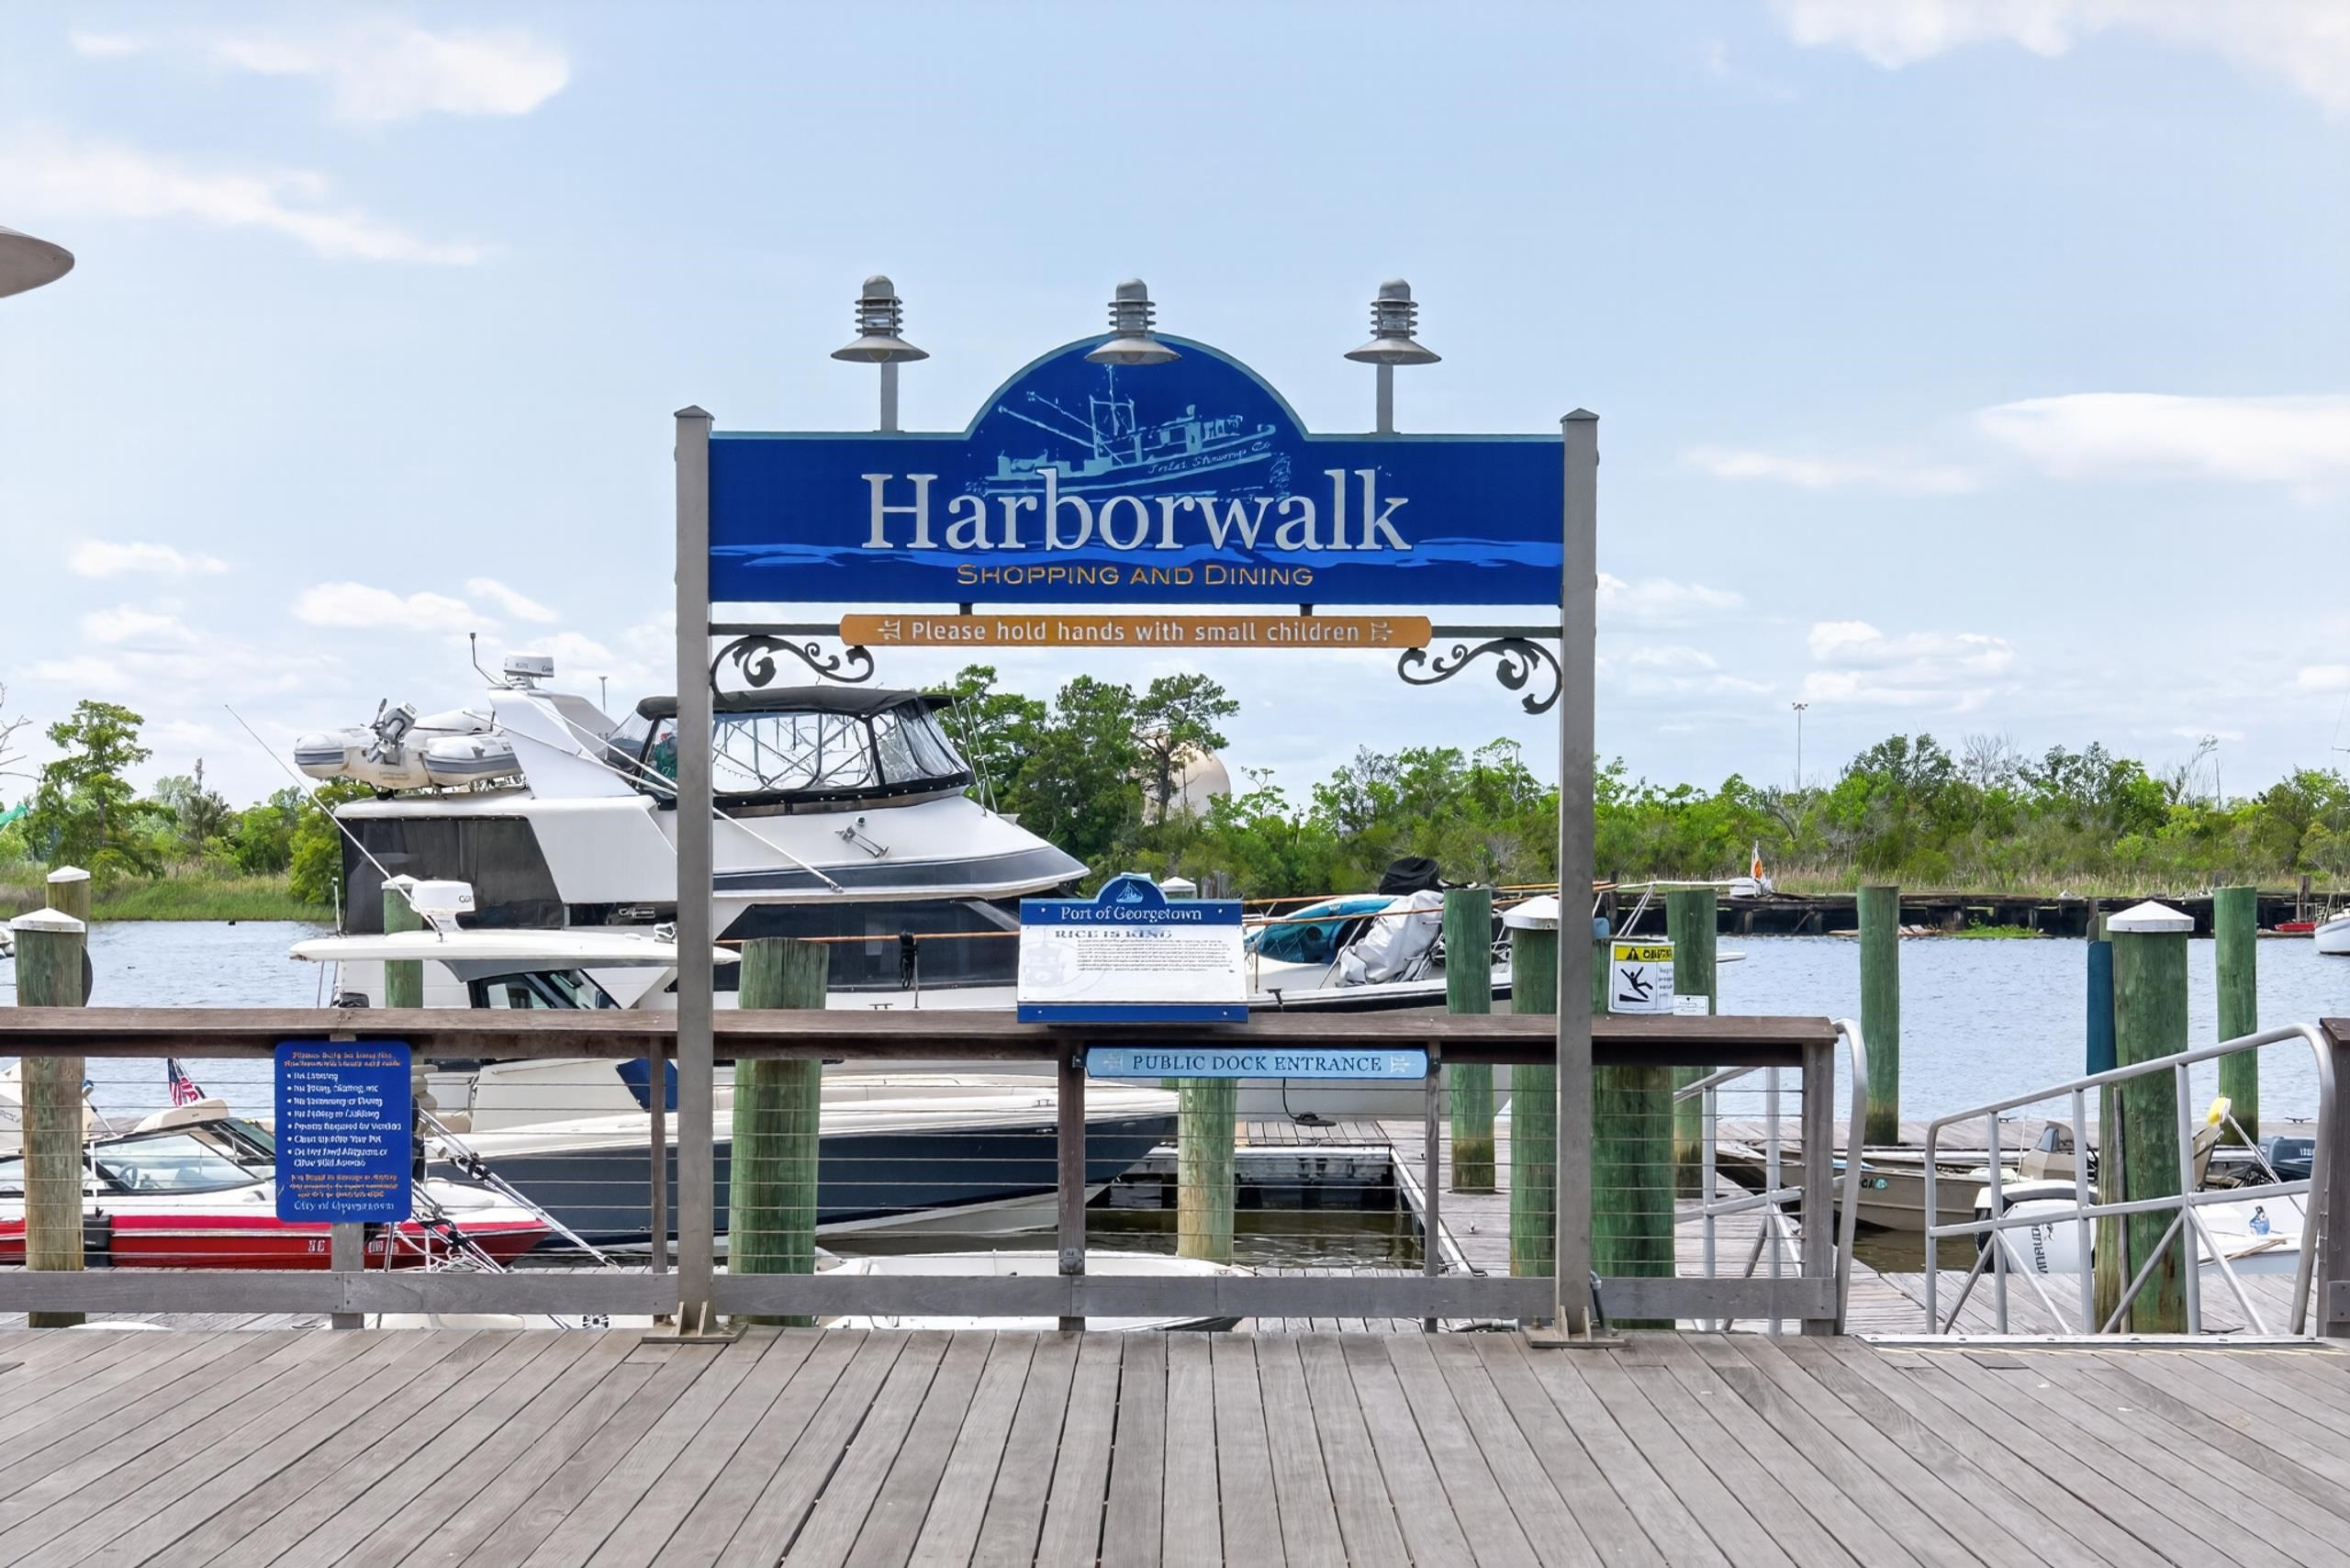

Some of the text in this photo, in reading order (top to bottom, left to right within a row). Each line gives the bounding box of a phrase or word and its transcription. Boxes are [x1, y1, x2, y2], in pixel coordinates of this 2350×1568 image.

[861, 468, 1413, 552] Harborwalk
[911, 620, 1360, 644] Please hold hands with small children
[1061, 906, 1202, 923] Port of Georgetown
[1055, 930, 1098, 938] RICE
[1132, 1055, 1382, 1072] PUBLIC DOCK ENTRANCE
